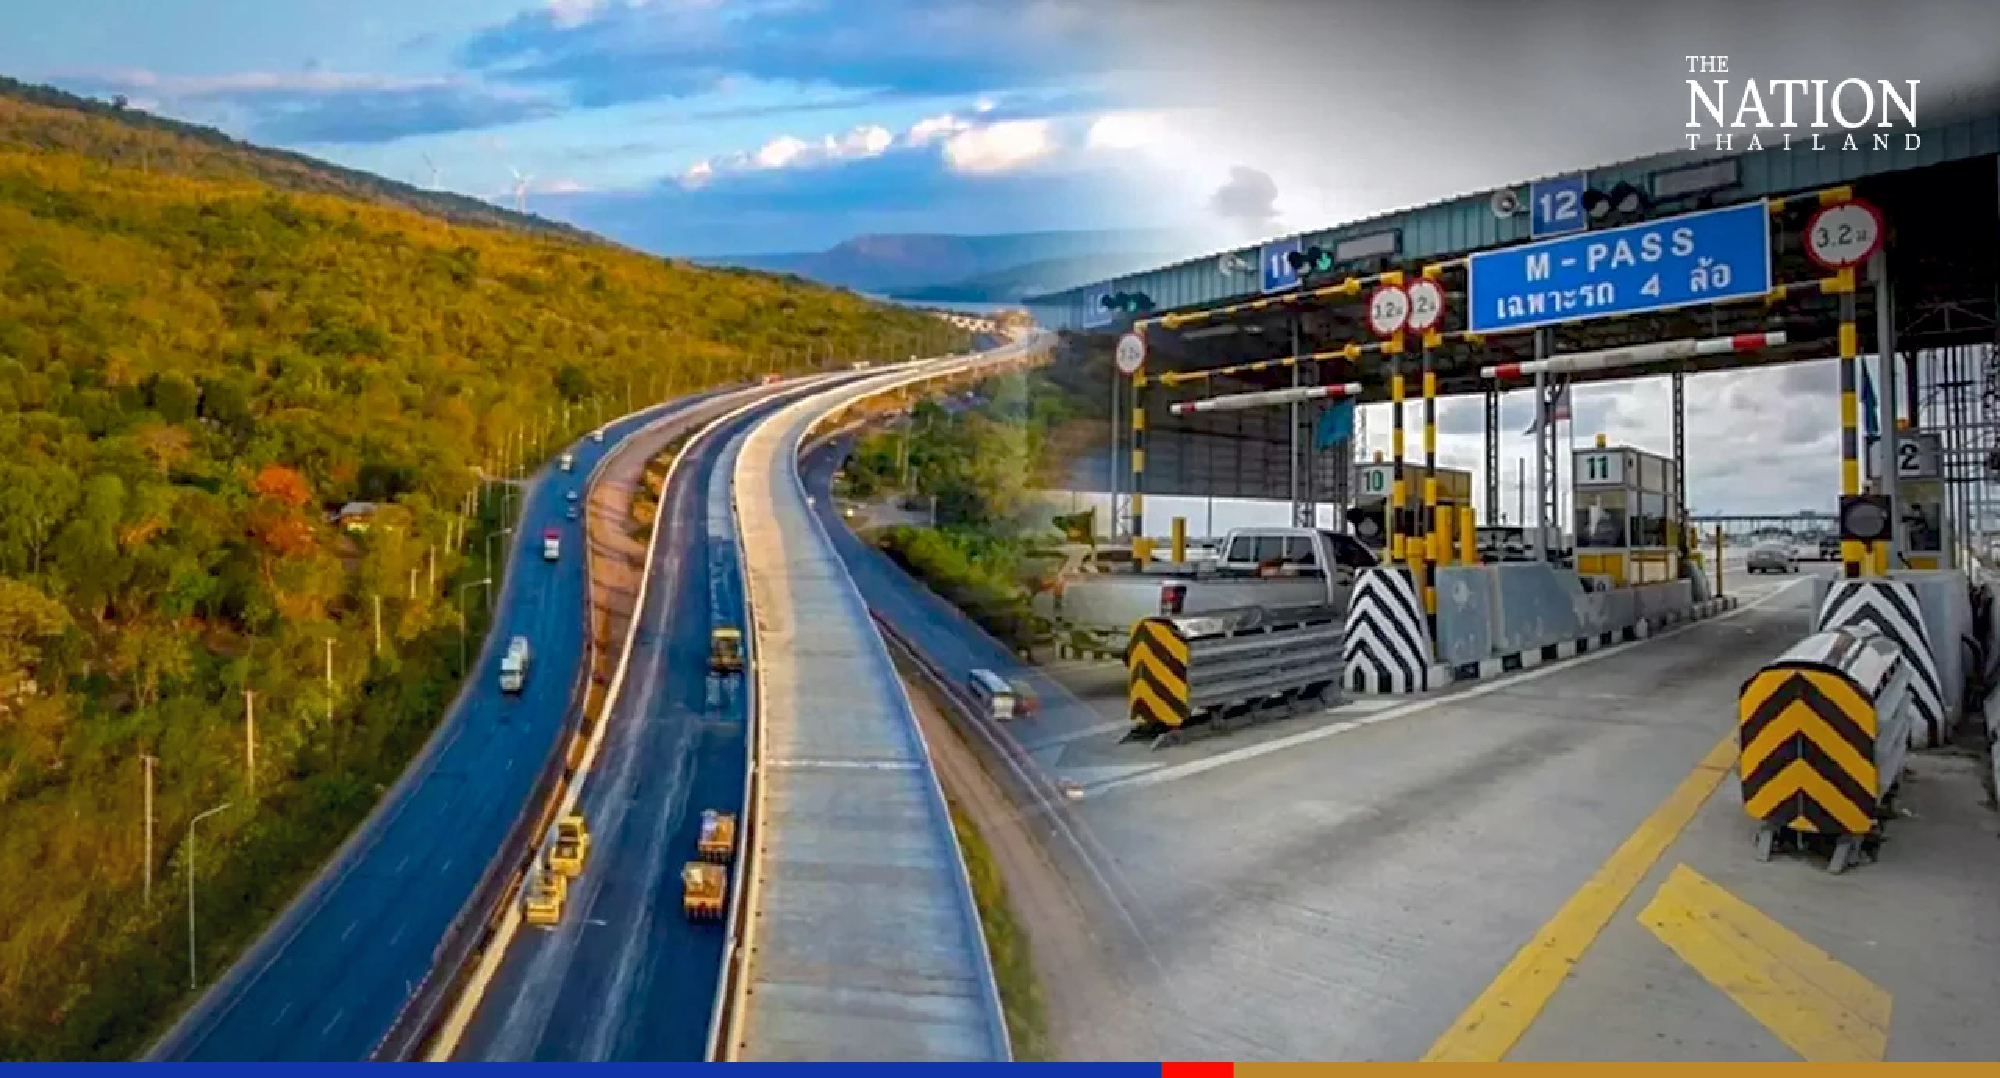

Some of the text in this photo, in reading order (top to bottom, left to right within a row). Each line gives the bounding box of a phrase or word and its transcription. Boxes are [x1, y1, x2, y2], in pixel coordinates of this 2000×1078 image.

[1540, 190, 1578, 223] 12
[1271, 251, 1291, 279] 11
[1496, 256, 1733, 320] เฉพาะรถ 4 ล้อ
[1363, 468, 1385, 493] 10
[1586, 455, 1609, 480] 11
